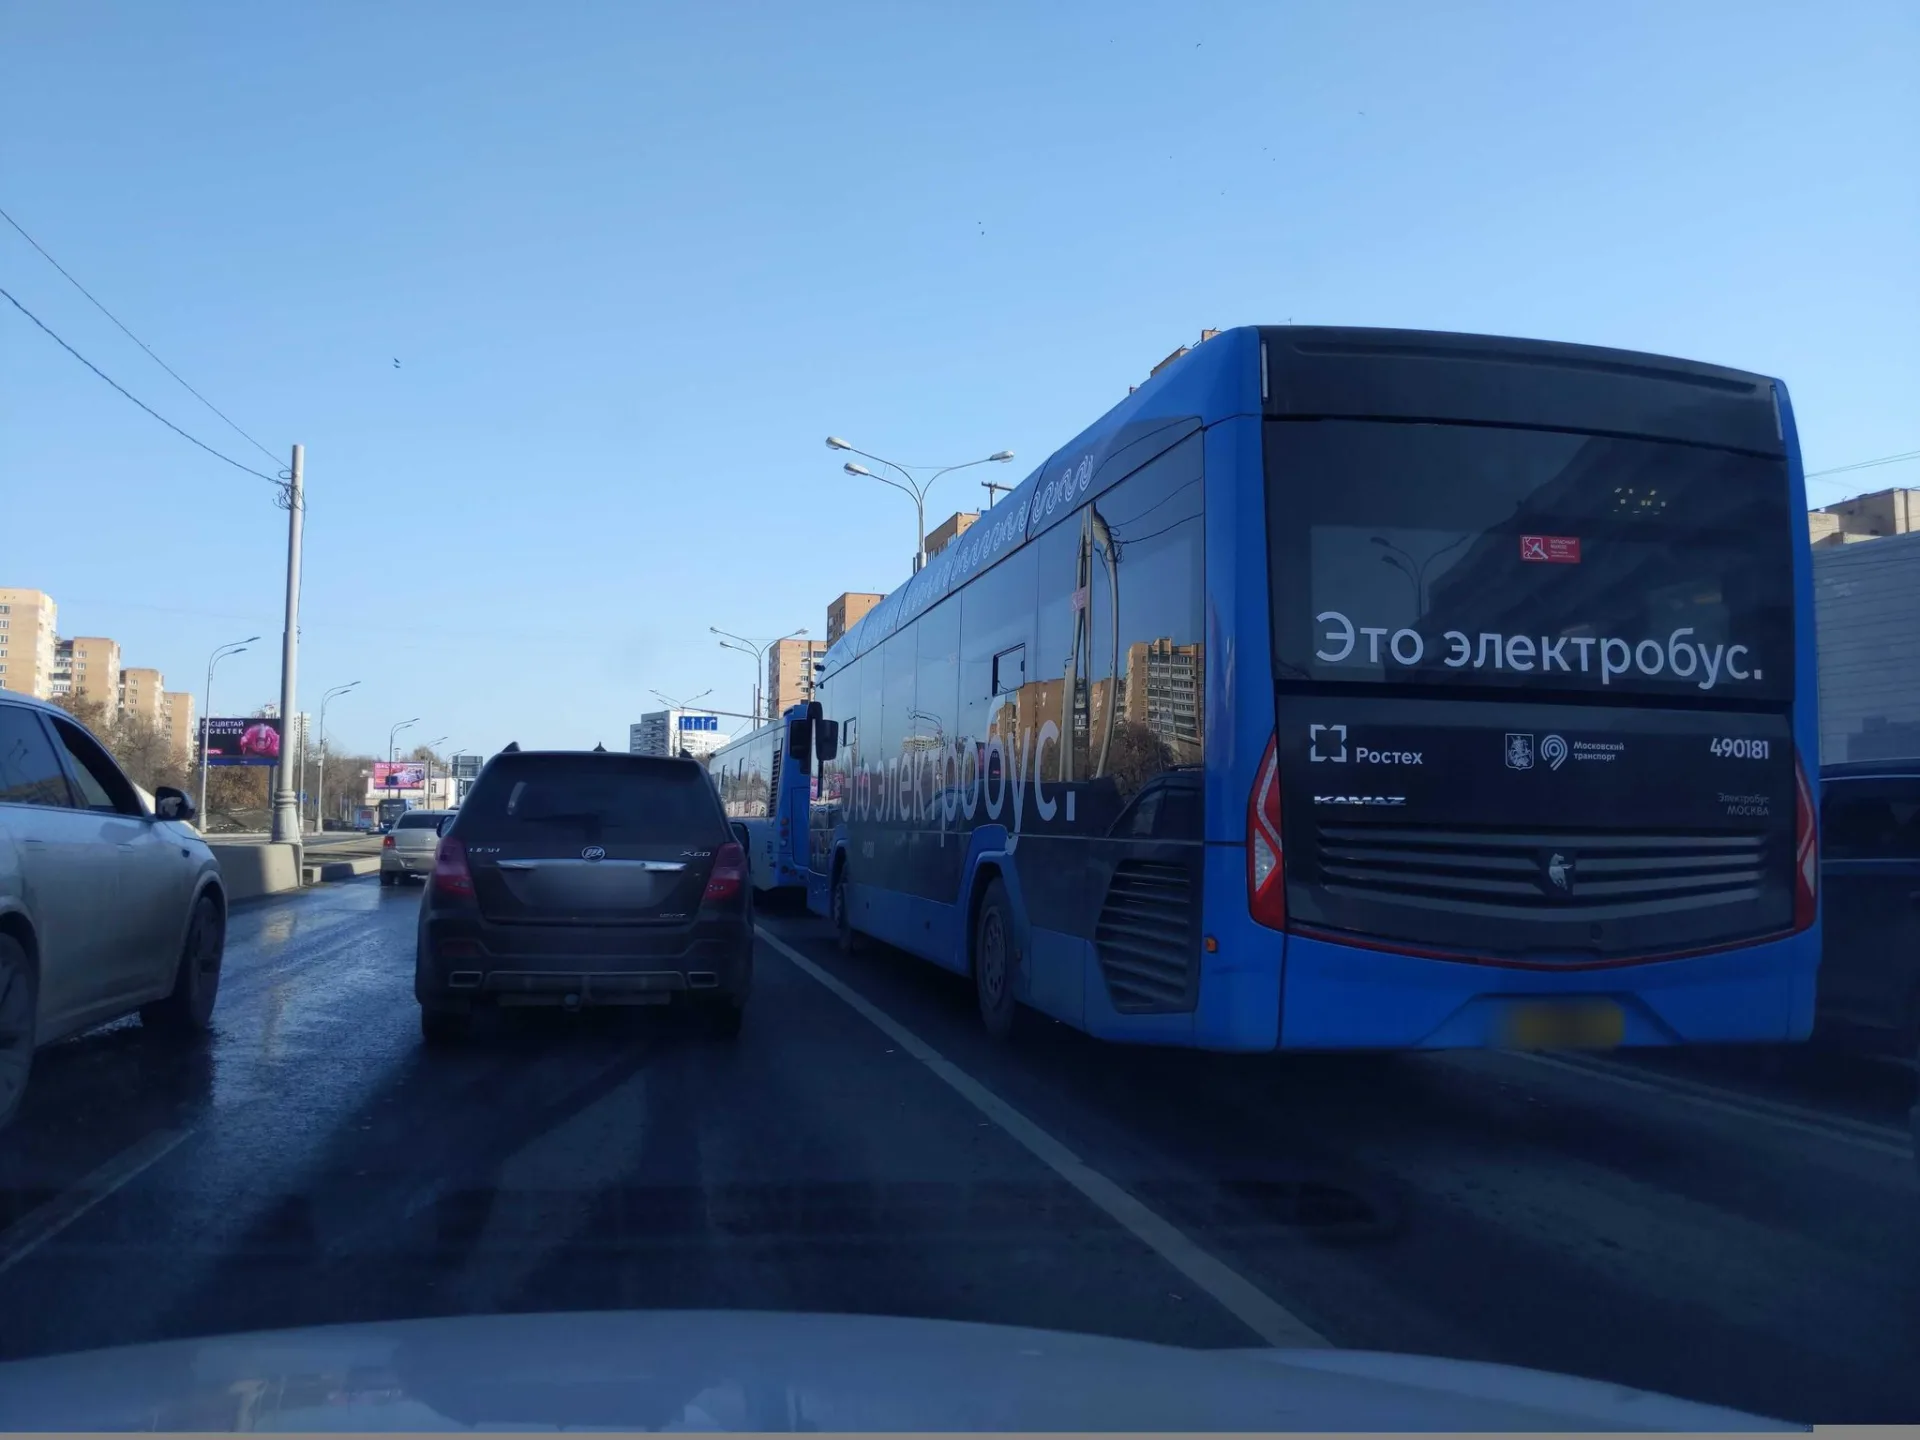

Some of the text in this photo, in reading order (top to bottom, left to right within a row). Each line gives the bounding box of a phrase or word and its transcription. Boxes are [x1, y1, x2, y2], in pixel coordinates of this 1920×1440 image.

[1315, 610, 1763, 690] Это электробус.
[1573, 741, 1625, 752] Московский
[1710, 737, 1769, 760] 490181
[1356, 746, 1424, 765] Ростех
[1573, 752, 1617, 762] транспорт
[1717, 792, 1770, 806] Электробус
[1726, 805, 1770, 816] МОСКВА
